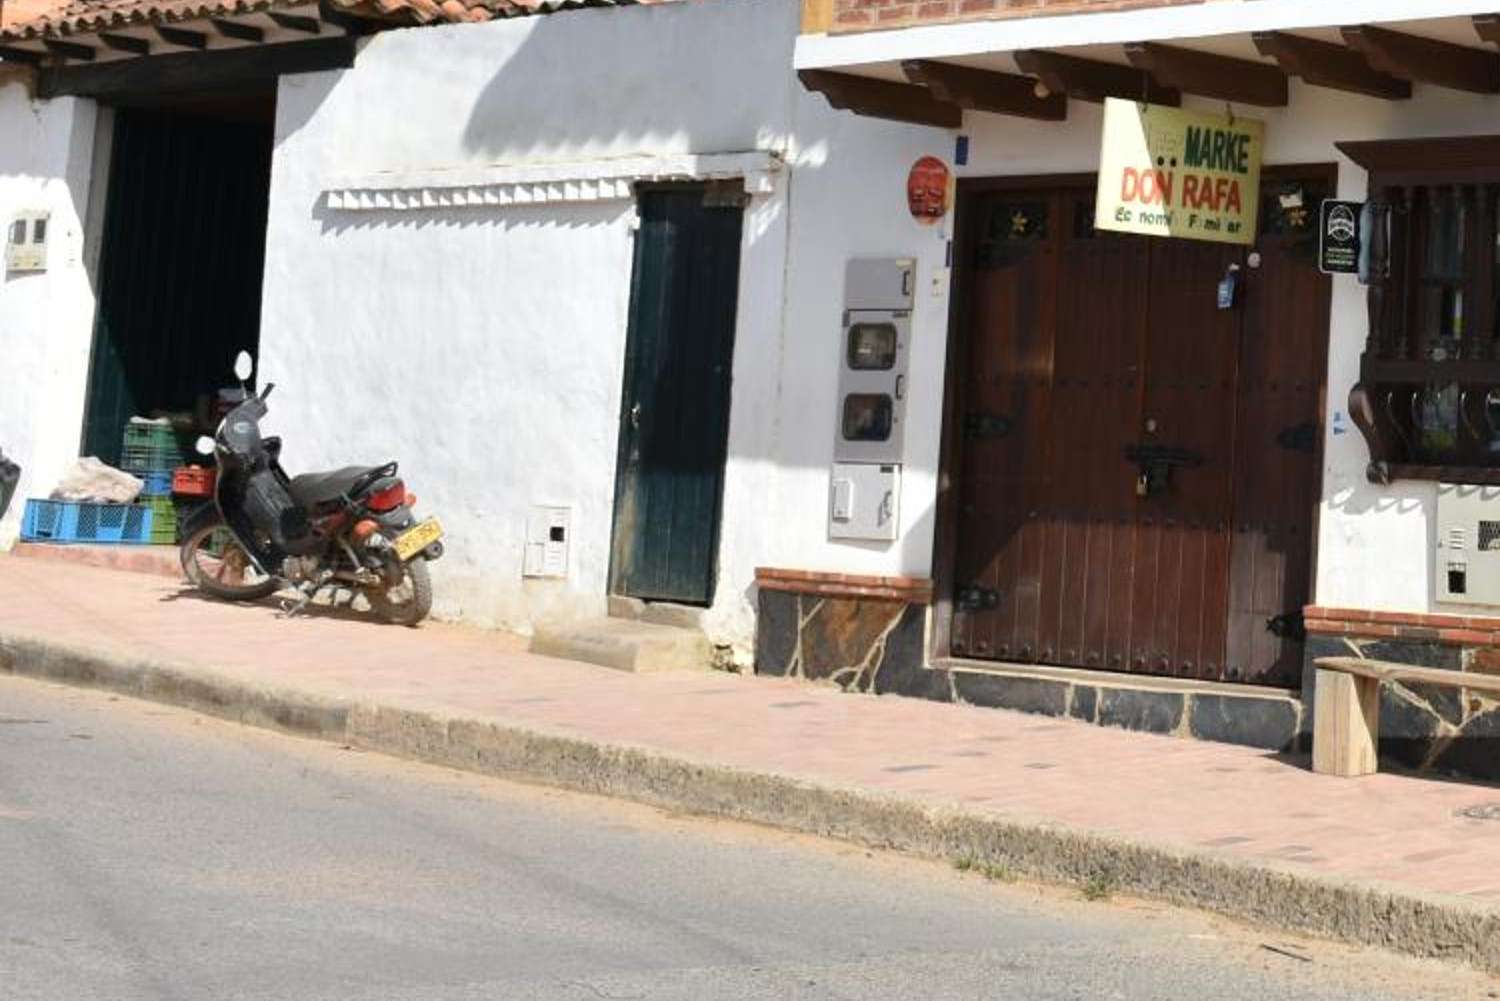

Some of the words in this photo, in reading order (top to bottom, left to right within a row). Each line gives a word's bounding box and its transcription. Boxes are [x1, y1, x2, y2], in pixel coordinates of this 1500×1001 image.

[1183, 125, 1251, 174] MARKE
[1121, 166, 1173, 206] DON
[1182, 174, 1242, 215] RAFA
